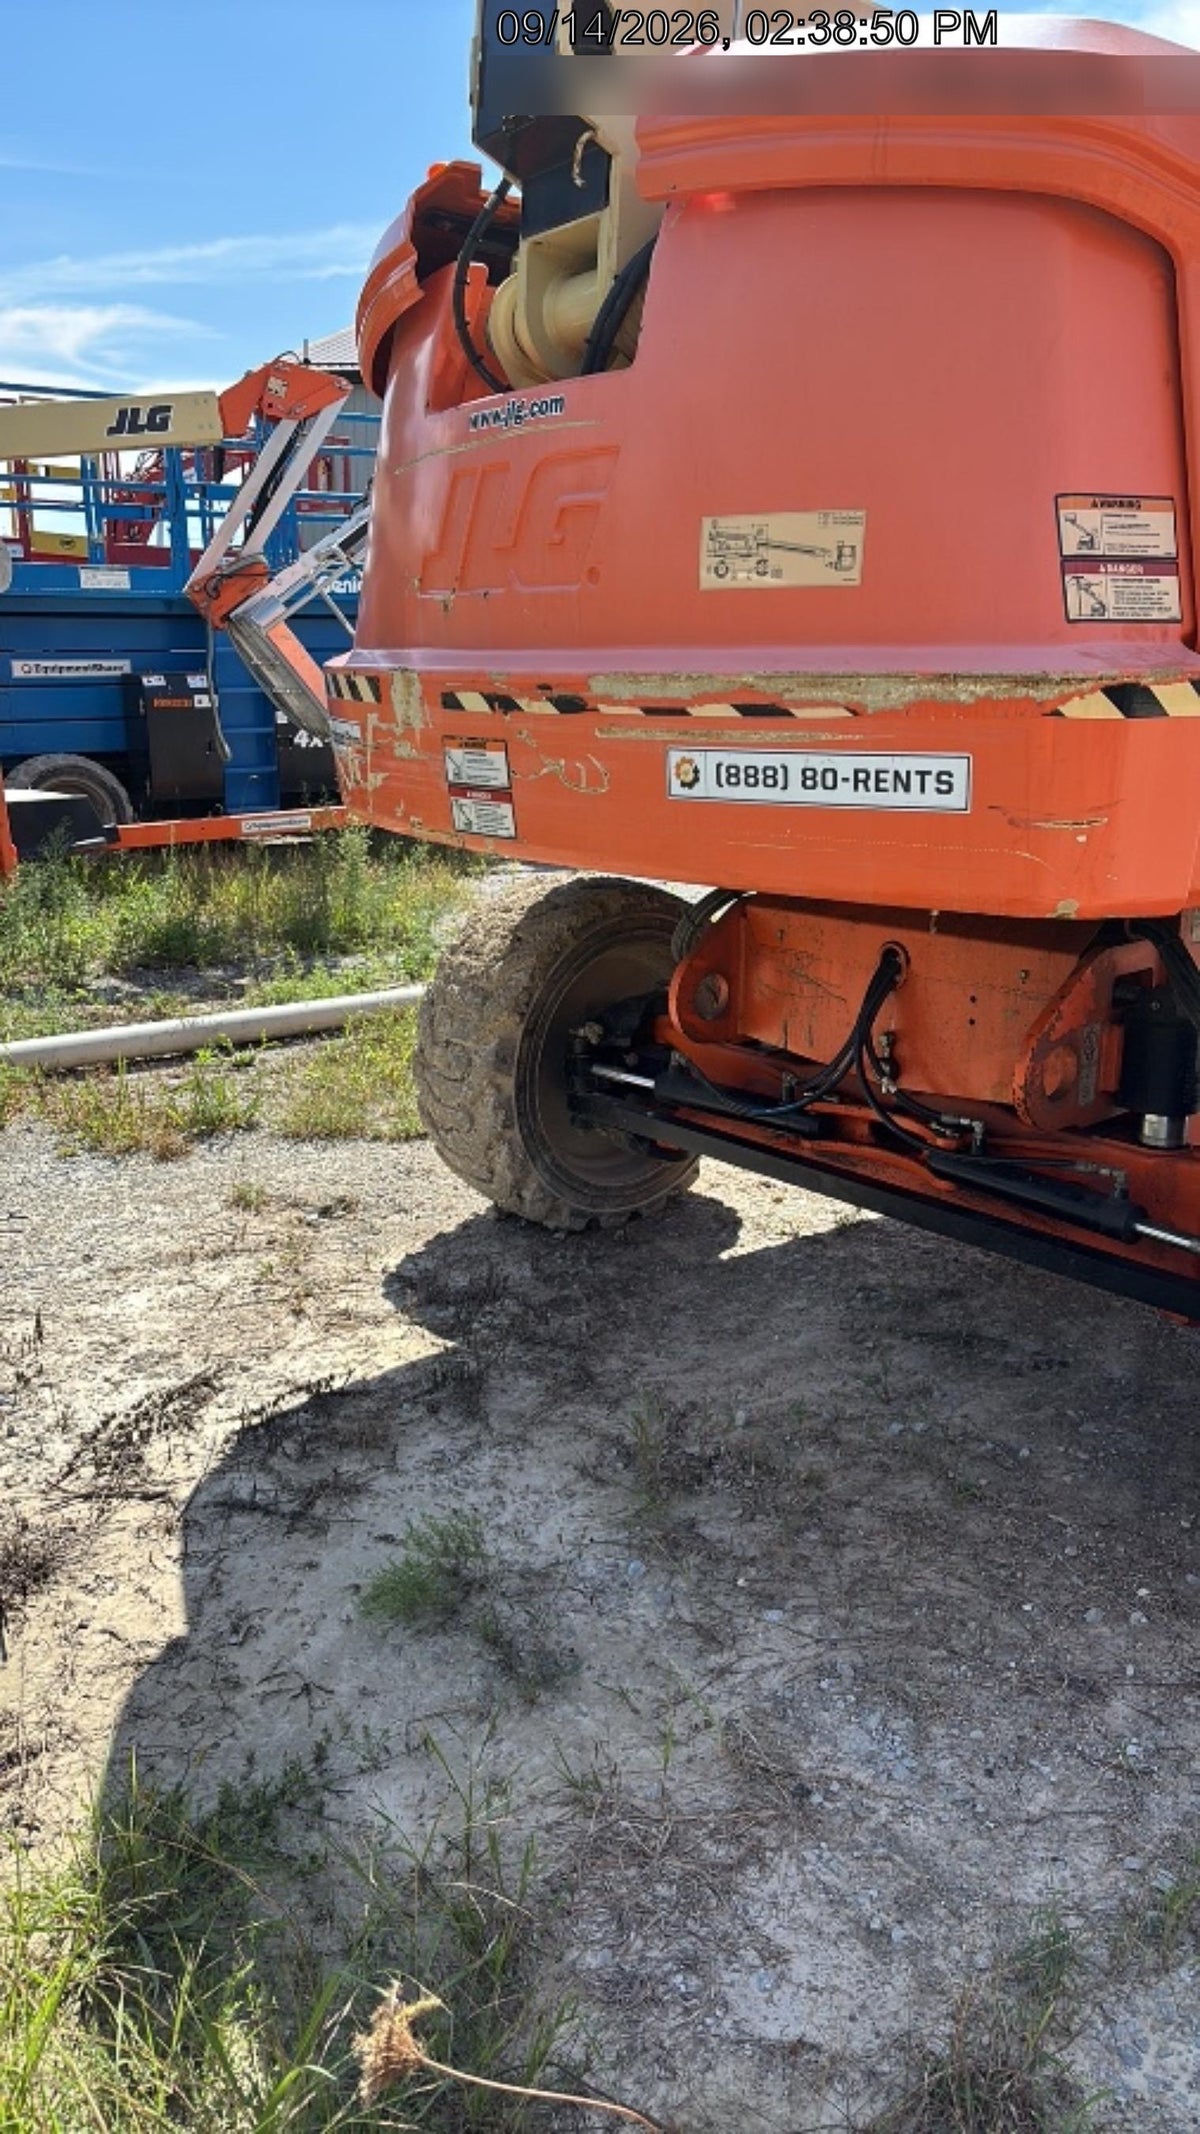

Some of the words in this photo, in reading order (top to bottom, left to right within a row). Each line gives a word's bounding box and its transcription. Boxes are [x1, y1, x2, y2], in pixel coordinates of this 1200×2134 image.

[106, 404, 173, 436] JLG
[469, 395, 565, 431] www.jlg.com
[716, 762, 788, 790] (888)
[800, 765, 955, 795] 80-RENTS
